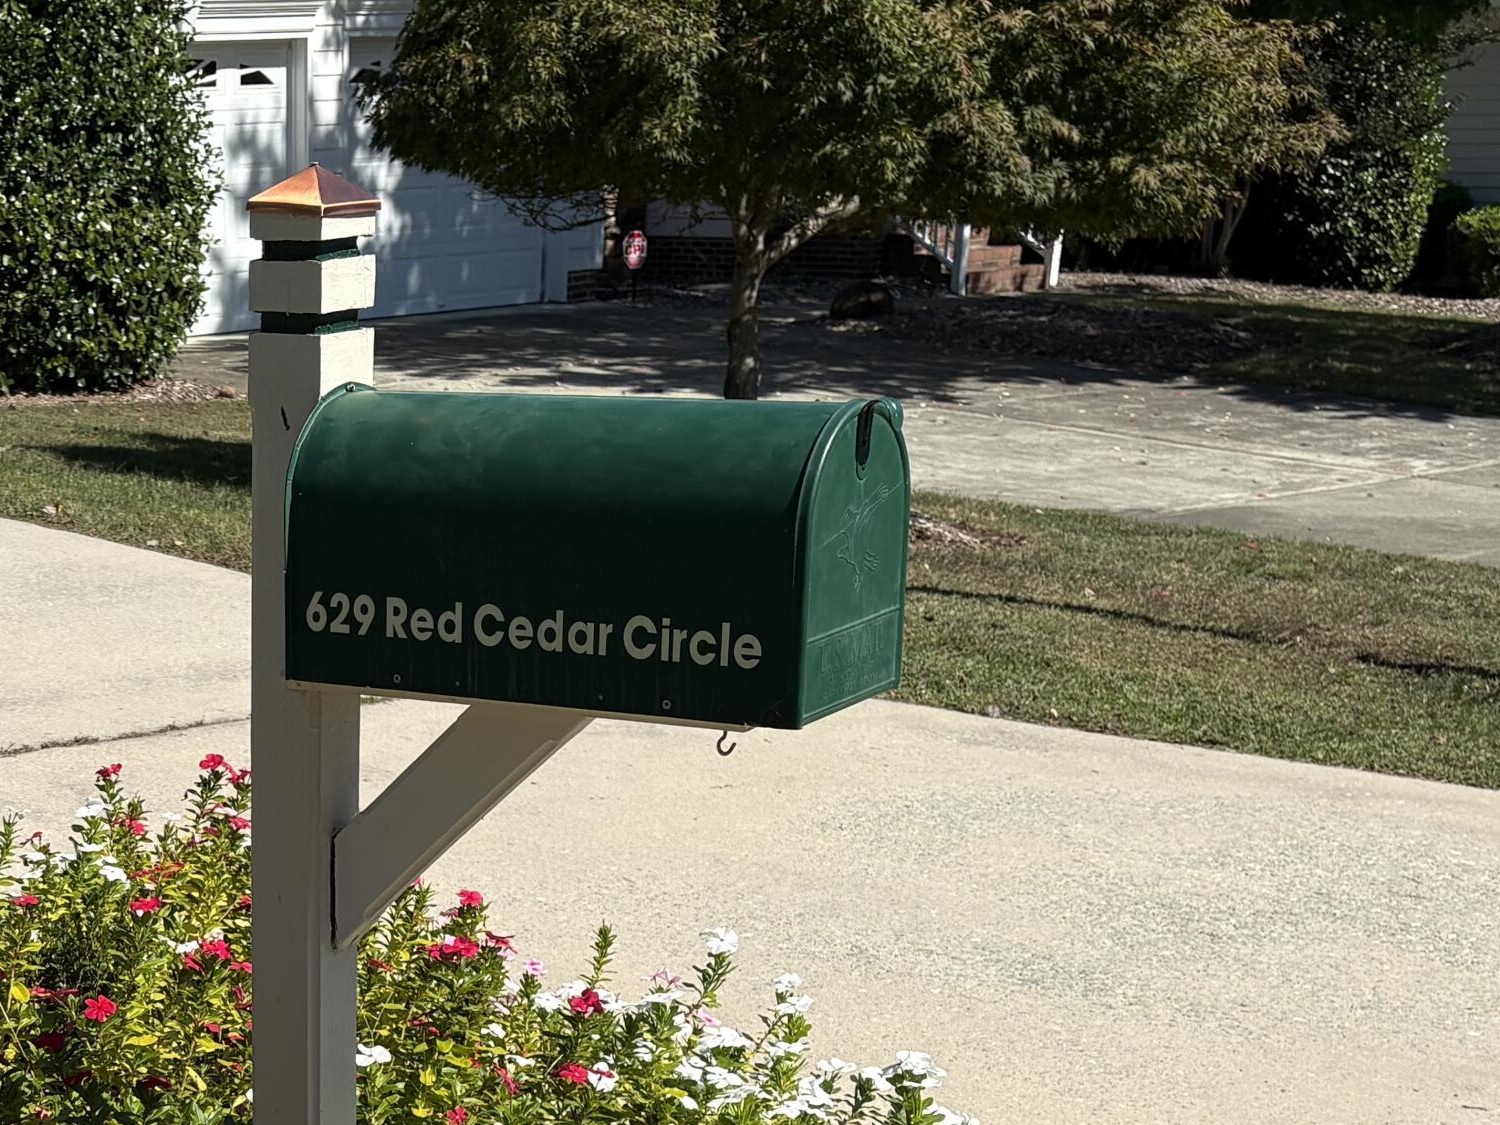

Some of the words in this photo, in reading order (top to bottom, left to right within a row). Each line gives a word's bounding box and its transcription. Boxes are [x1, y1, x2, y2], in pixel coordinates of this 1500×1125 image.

[306, 591, 376, 636] 629
[386, 596, 463, 644] Red
[473, 604, 614, 657] Cedar
[623, 615, 762, 670] Circle
